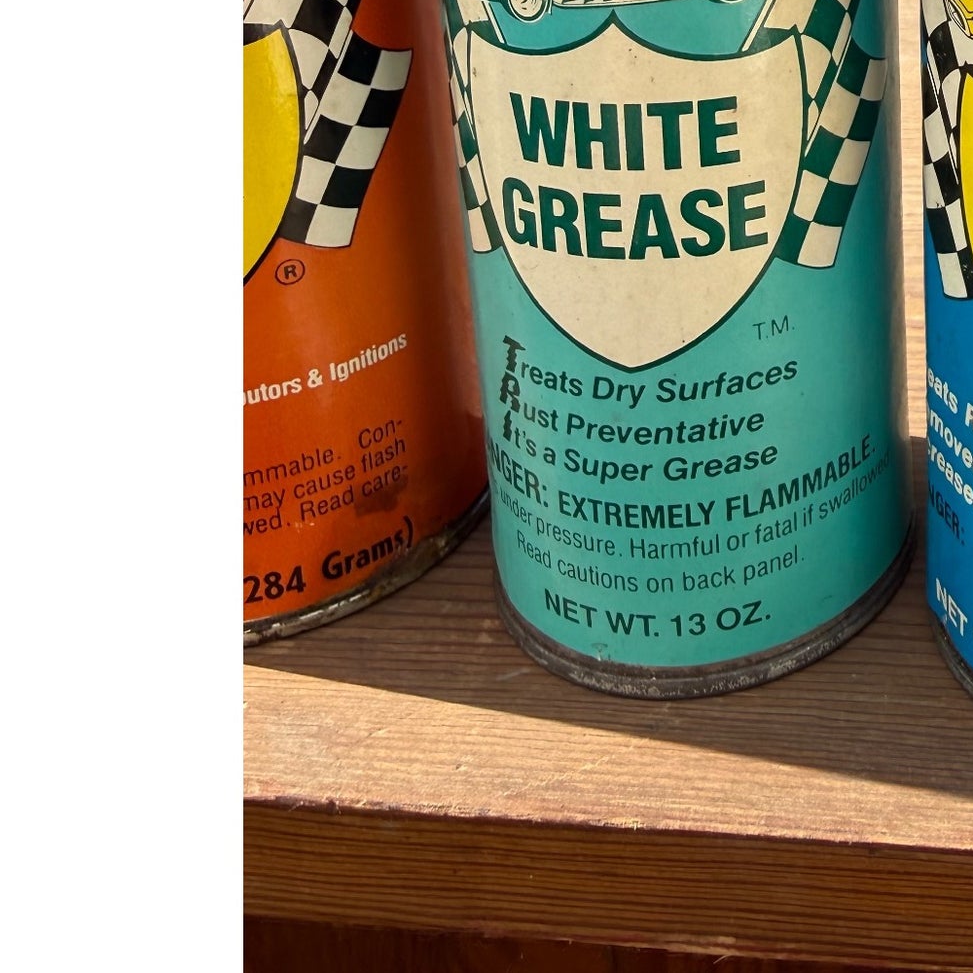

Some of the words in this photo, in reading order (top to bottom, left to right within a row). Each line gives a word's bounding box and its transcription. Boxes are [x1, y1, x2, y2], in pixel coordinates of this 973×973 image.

[509, 92, 741, 171] WHITE
[502, 177, 769, 260] GREASE
[753, 315, 795, 340] T.M.
[307, 369, 323, 389] &
[329, 333, 408, 385] Ignitions
[502, 334, 583, 397] Treats
[592, 376, 646, 409] Dry
[656, 360, 798, 403] Surfaces
[358, 419, 402, 449] Con-
[499, 371, 559, 433] Rust
[567, 413, 765, 445] Preventative
[293, 464, 355, 500] cause
[361, 438, 406, 473] flash
[300, 484, 354, 522] Read
[361, 464, 408, 498] care-
[543, 446, 557, 466] a
[564, 449, 653, 484] Super
[663, 445, 778, 482] Grease
[559, 490, 715, 529] EXTREMELY
[726, 433, 876, 521] FLAMMABLE.
[500, 488, 532, 526] under
[536, 517, 623, 557] pressure.
[630, 534, 720, 560] Harmful
[727, 532, 750, 553] or
[755, 511, 798, 545] fatal
[803, 503, 814, 527] if
[243, 565, 306, 604] 284
[322, 515, 414, 580] Grams)
[517, 529, 552, 569] Read
[557, 558, 639, 593] cautions
[646, 576, 674, 594] on
[683, 565, 736, 593] back
[743, 545, 805, 586] panel.
[544, 588, 598, 628] NET
[605, 610, 660, 637] WT.
[670, 612, 706, 637] 13
[716, 600, 771, 631] OZ.
[935, 577, 968, 637] NET
